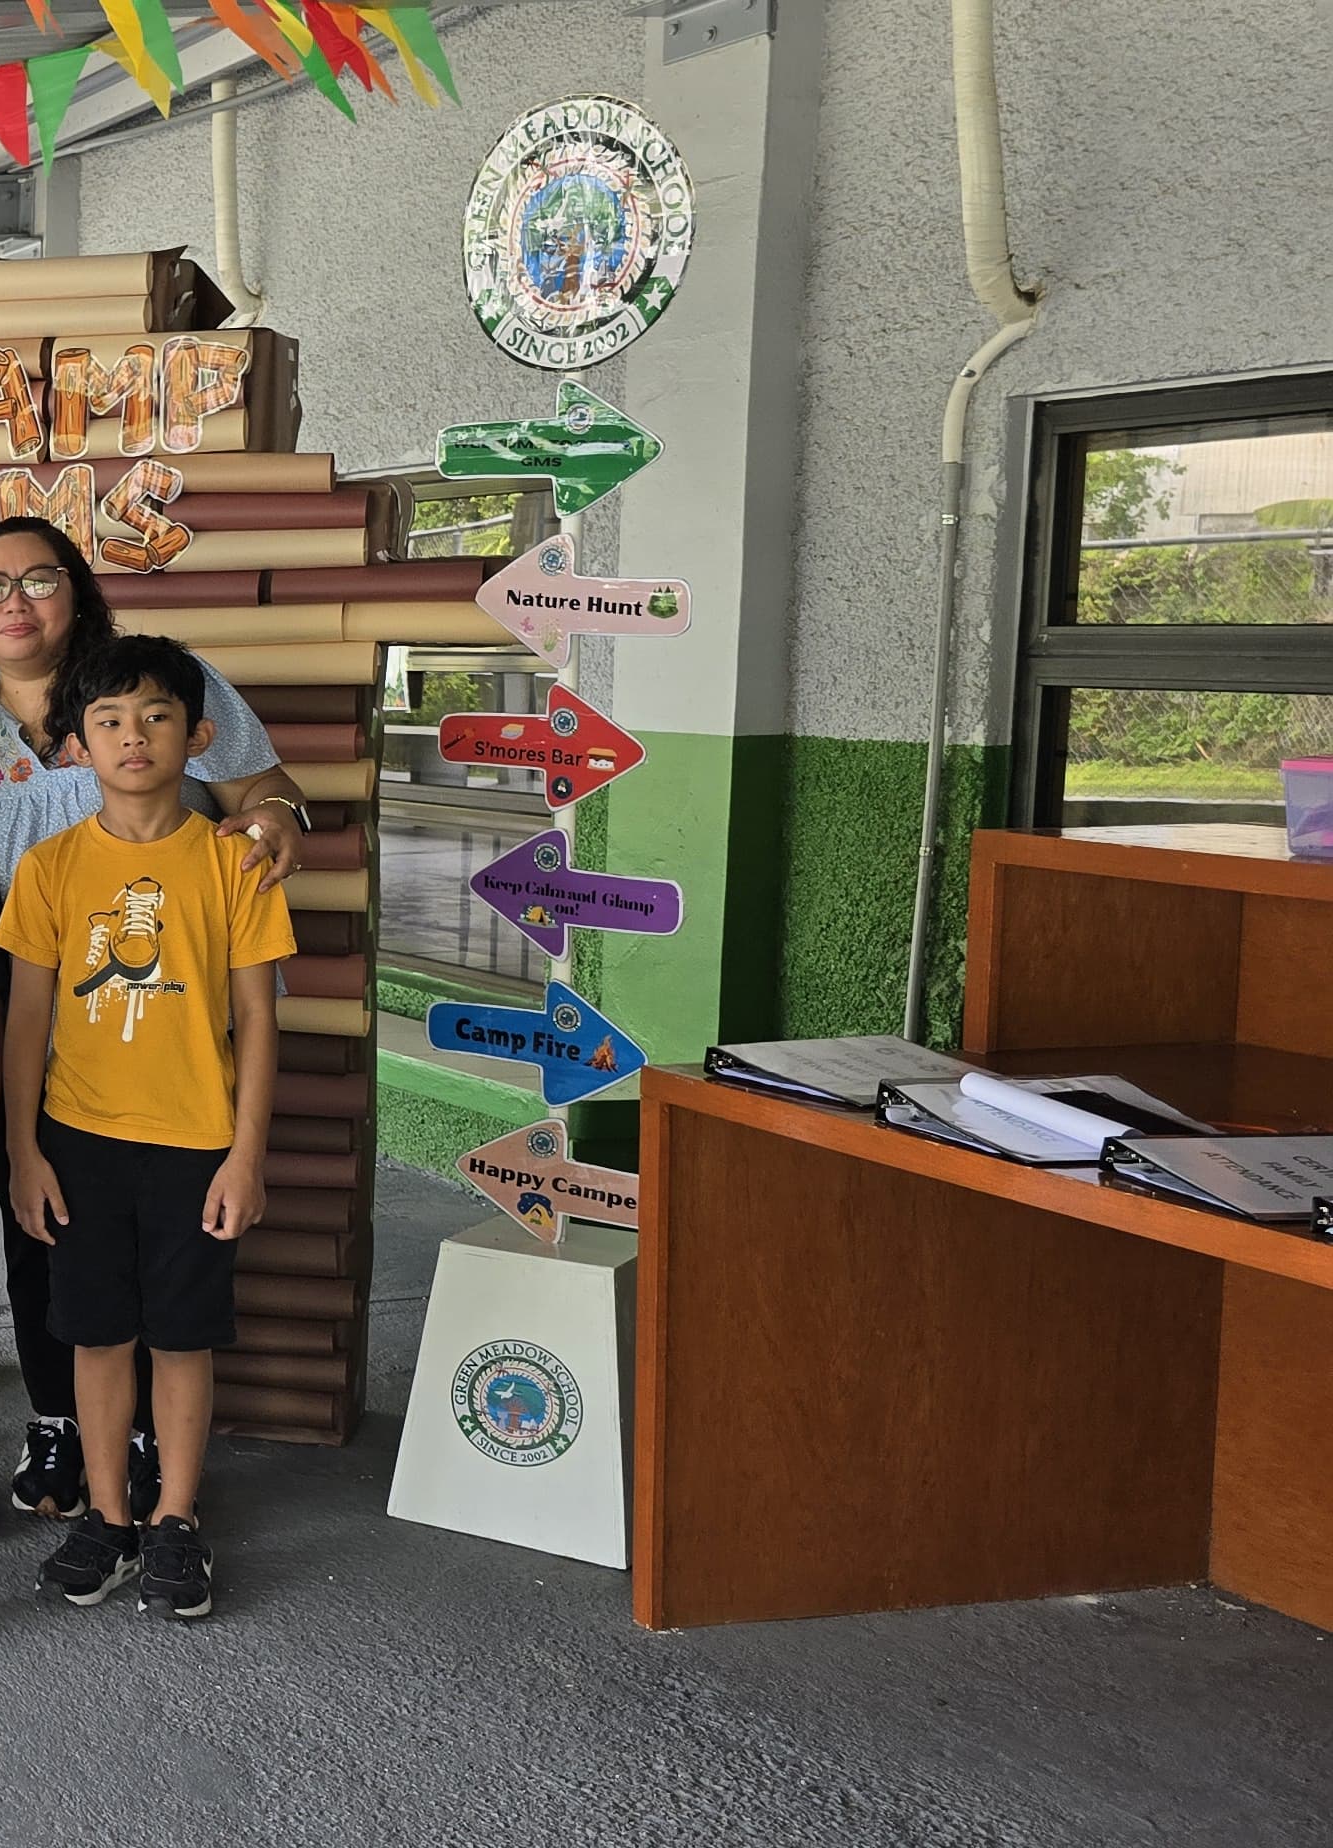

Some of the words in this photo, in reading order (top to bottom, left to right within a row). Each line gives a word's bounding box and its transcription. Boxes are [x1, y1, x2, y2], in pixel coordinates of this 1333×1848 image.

[499, 103, 632, 161] MEADOW
[632, 124, 689, 255] SCHOOL
[506, 327, 577, 364] SINCE
[583, 323, 630, 359] 2002
[521, 456, 562, 468] GMS
[506, 589, 581, 611] Nature
[587, 596, 643, 617] Hunt
[474, 741, 546, 763] S'mores
[551, 748, 583, 767] Bar
[483, 875, 523, 896] Keep
[525, 881, 566, 899] Calm
[567, 889, 596, 905] and
[602, 892, 655, 916] Glamp
[554, 903, 581, 917] on!
[126, 982, 162, 992] power
[163, 981, 185, 993] play
[455, 1017, 527, 1055] Camp
[532, 1031, 581, 1062] Fire
[469, 1158, 545, 1190] Happy
[552, 1177, 638, 1210] Campe
[1200, 1151, 1303, 1200] ATTENDANCE
[1261, 1161, 1323, 1188] FAMILY
[455, 1357, 479, 1405] GREEN
[478, 1343, 552, 1366] MEADOW
[551, 1364, 580, 1426] SCHOOL
[476, 1437, 518, 1462] SINCE
[521, 1450, 549, 1462] 2002
